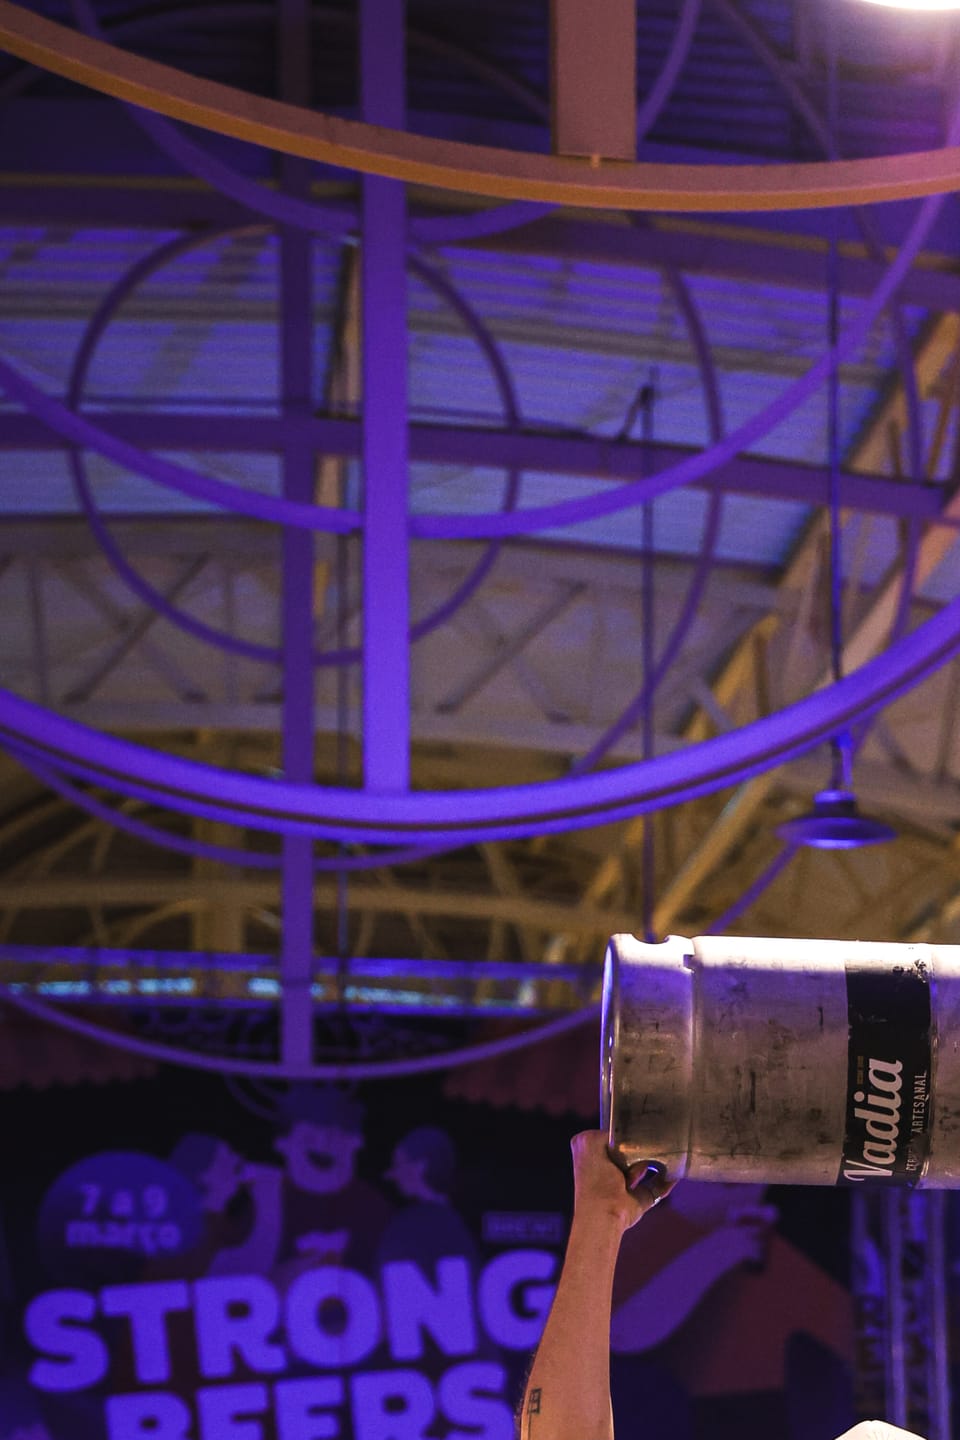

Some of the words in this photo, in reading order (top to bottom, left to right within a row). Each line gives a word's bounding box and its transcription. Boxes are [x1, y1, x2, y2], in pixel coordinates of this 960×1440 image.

[843, 1058, 903, 1181] Vadia
[911, 1071, 929, 1132] ARTESANAL
[24, 1249, 559, 1392] STRONG
